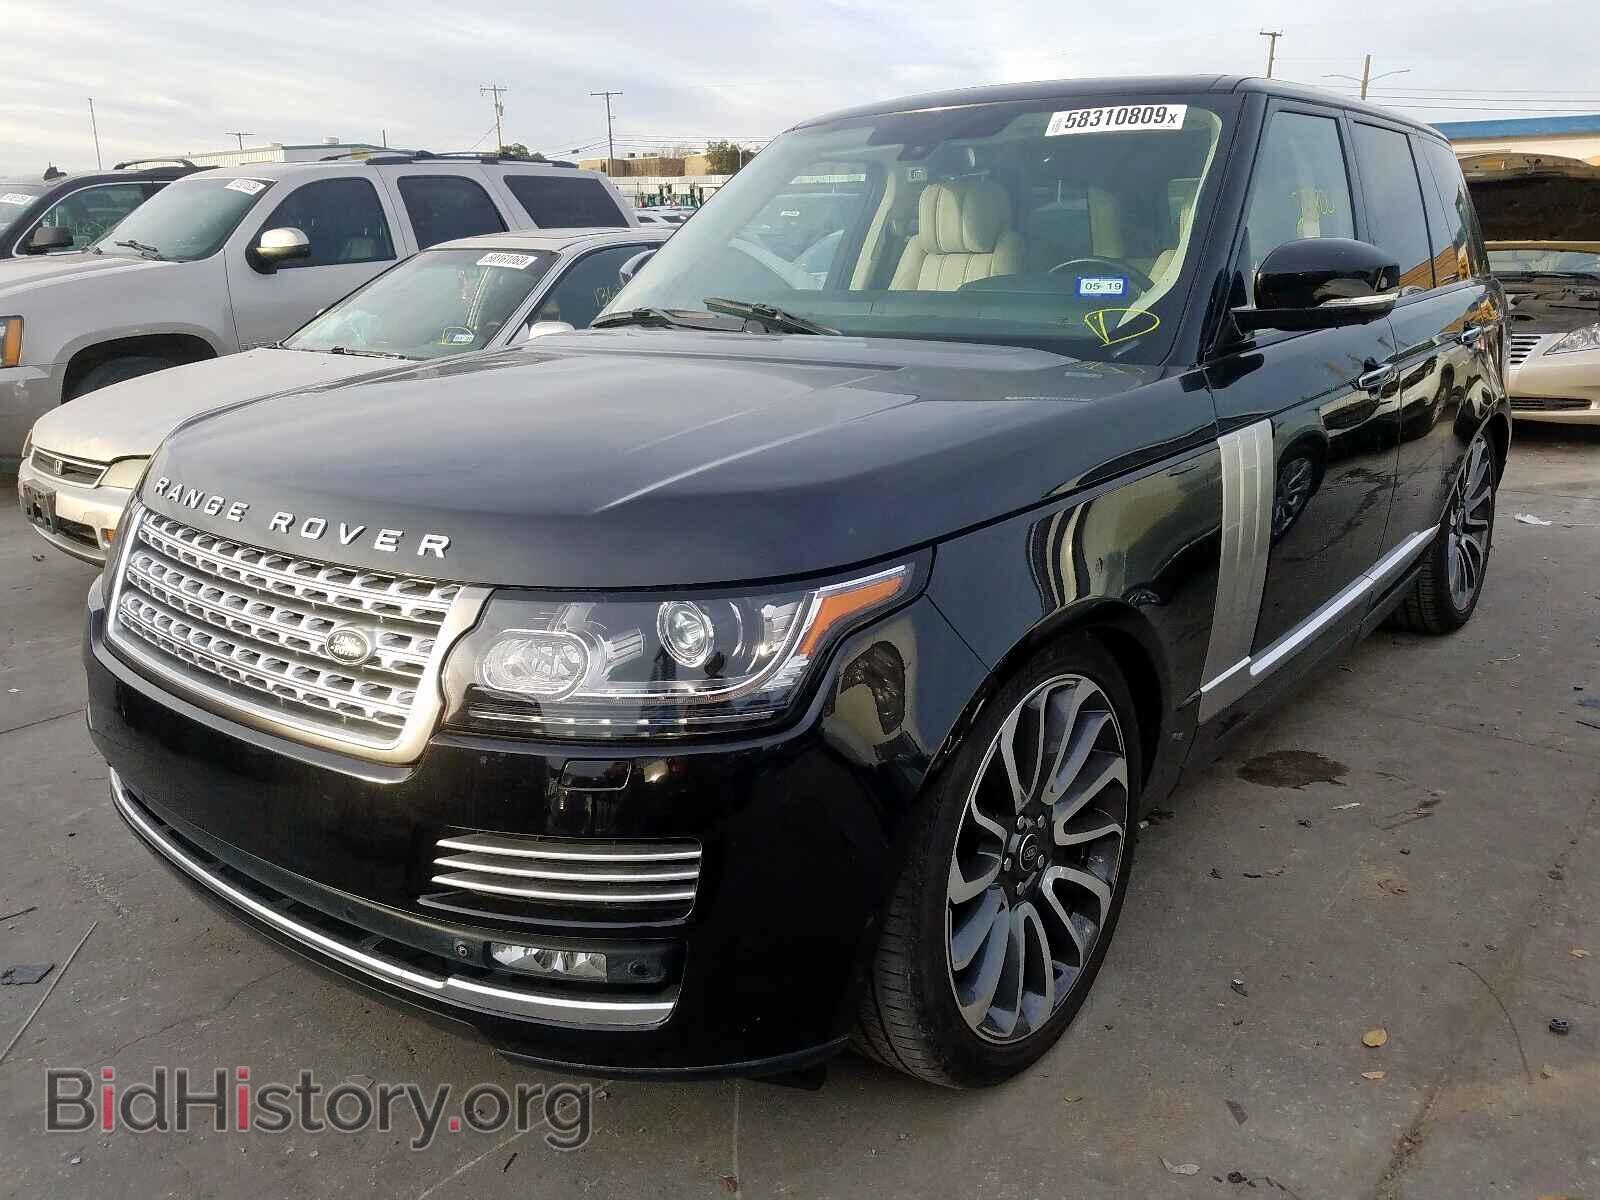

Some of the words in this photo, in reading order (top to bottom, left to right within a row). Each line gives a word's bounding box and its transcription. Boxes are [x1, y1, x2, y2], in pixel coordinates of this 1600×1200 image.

[1085, 282, 1100, 290] 05
[1107, 282, 1122, 290] 19
[153, 477, 249, 522] RANGE
[268, 511, 451, 559] ROVER
